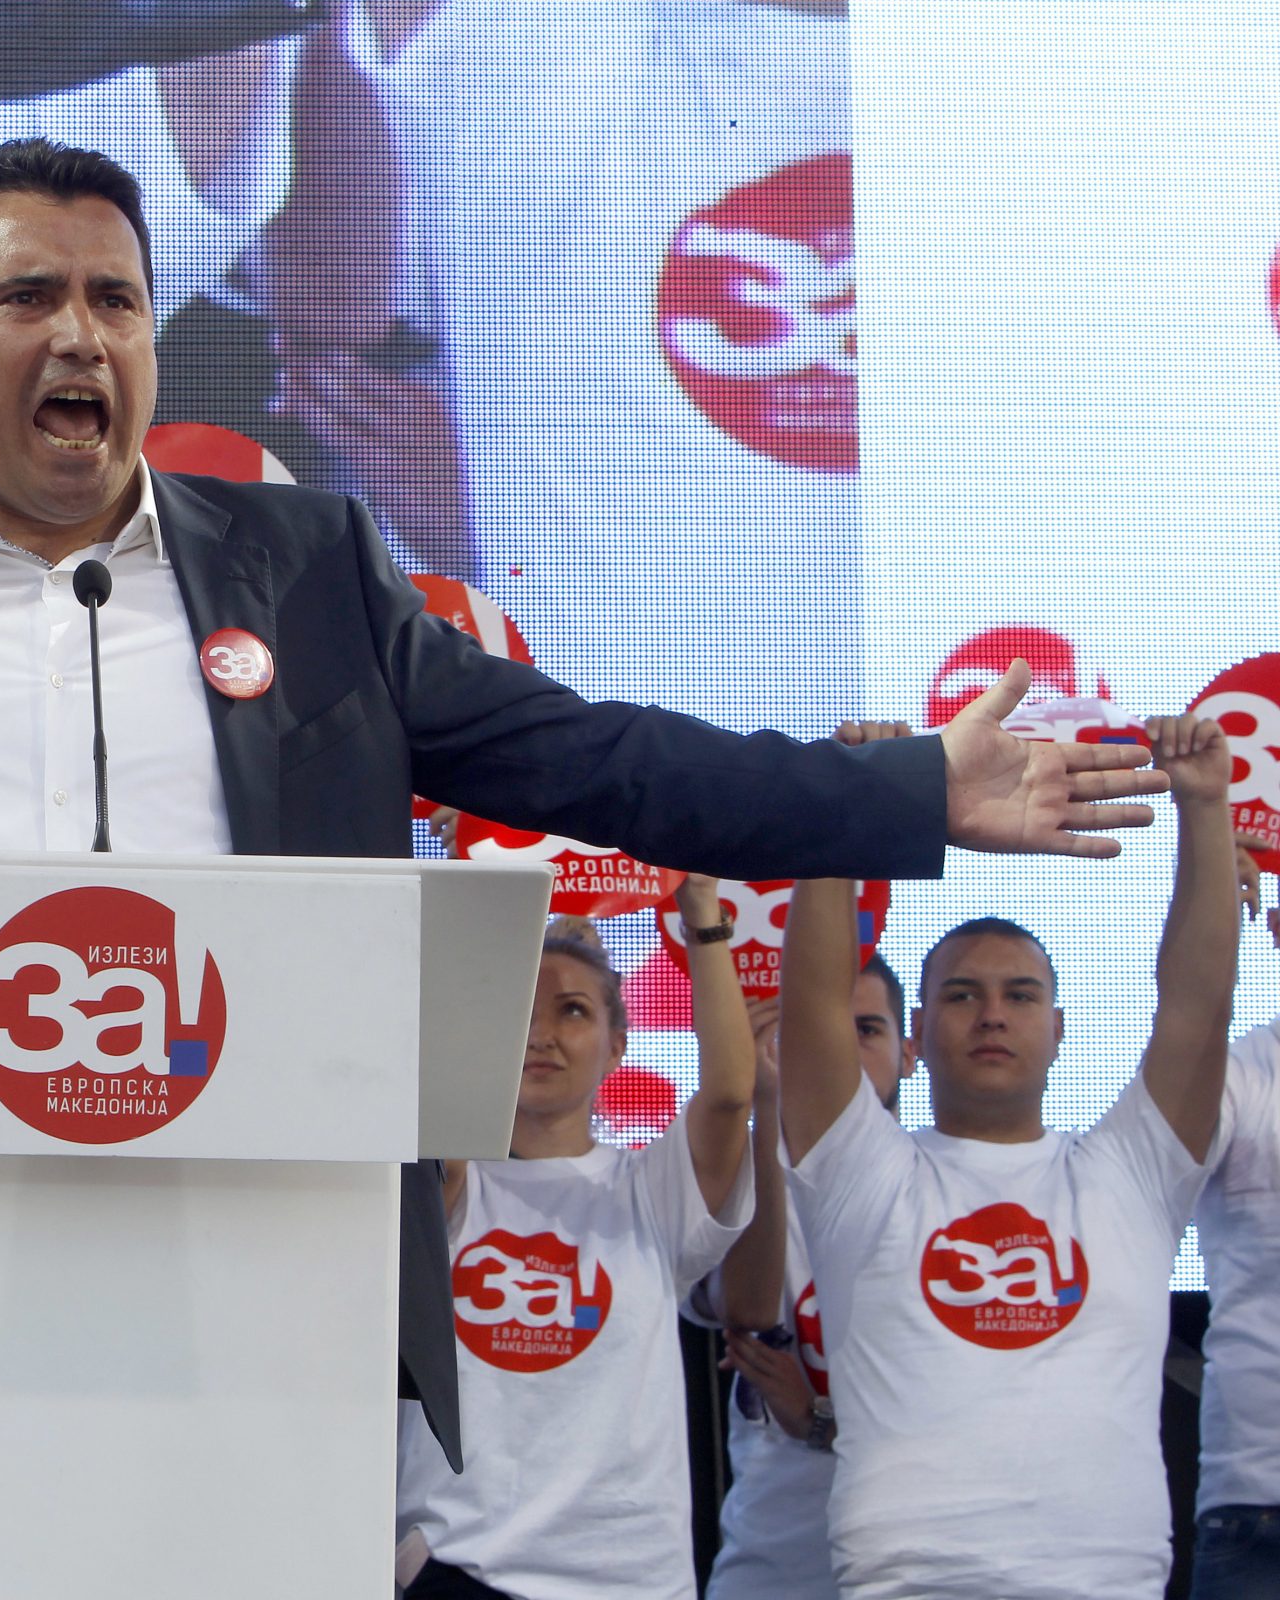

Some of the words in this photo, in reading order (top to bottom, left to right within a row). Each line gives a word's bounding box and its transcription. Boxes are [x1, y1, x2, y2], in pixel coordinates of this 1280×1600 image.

[554, 858, 660, 877] ВРОПСКА
[554, 876, 661, 896] АКЕДОНИЈА
[88, 945, 168, 965] ИЗЛЕЗИ
[47, 1077, 169, 1096] ЕВРОПСКА
[46, 1097, 169, 1116] МАКЕДОНИЈА
[974, 1306, 1059, 1319] ЕВРОПСКА
[492, 1326, 573, 1341] ЕВРОПСКА
[974, 1319, 1059, 1332] МАКЕДОНИЈА
[491, 1340, 573, 1355] МАКЕДОНИЈА
